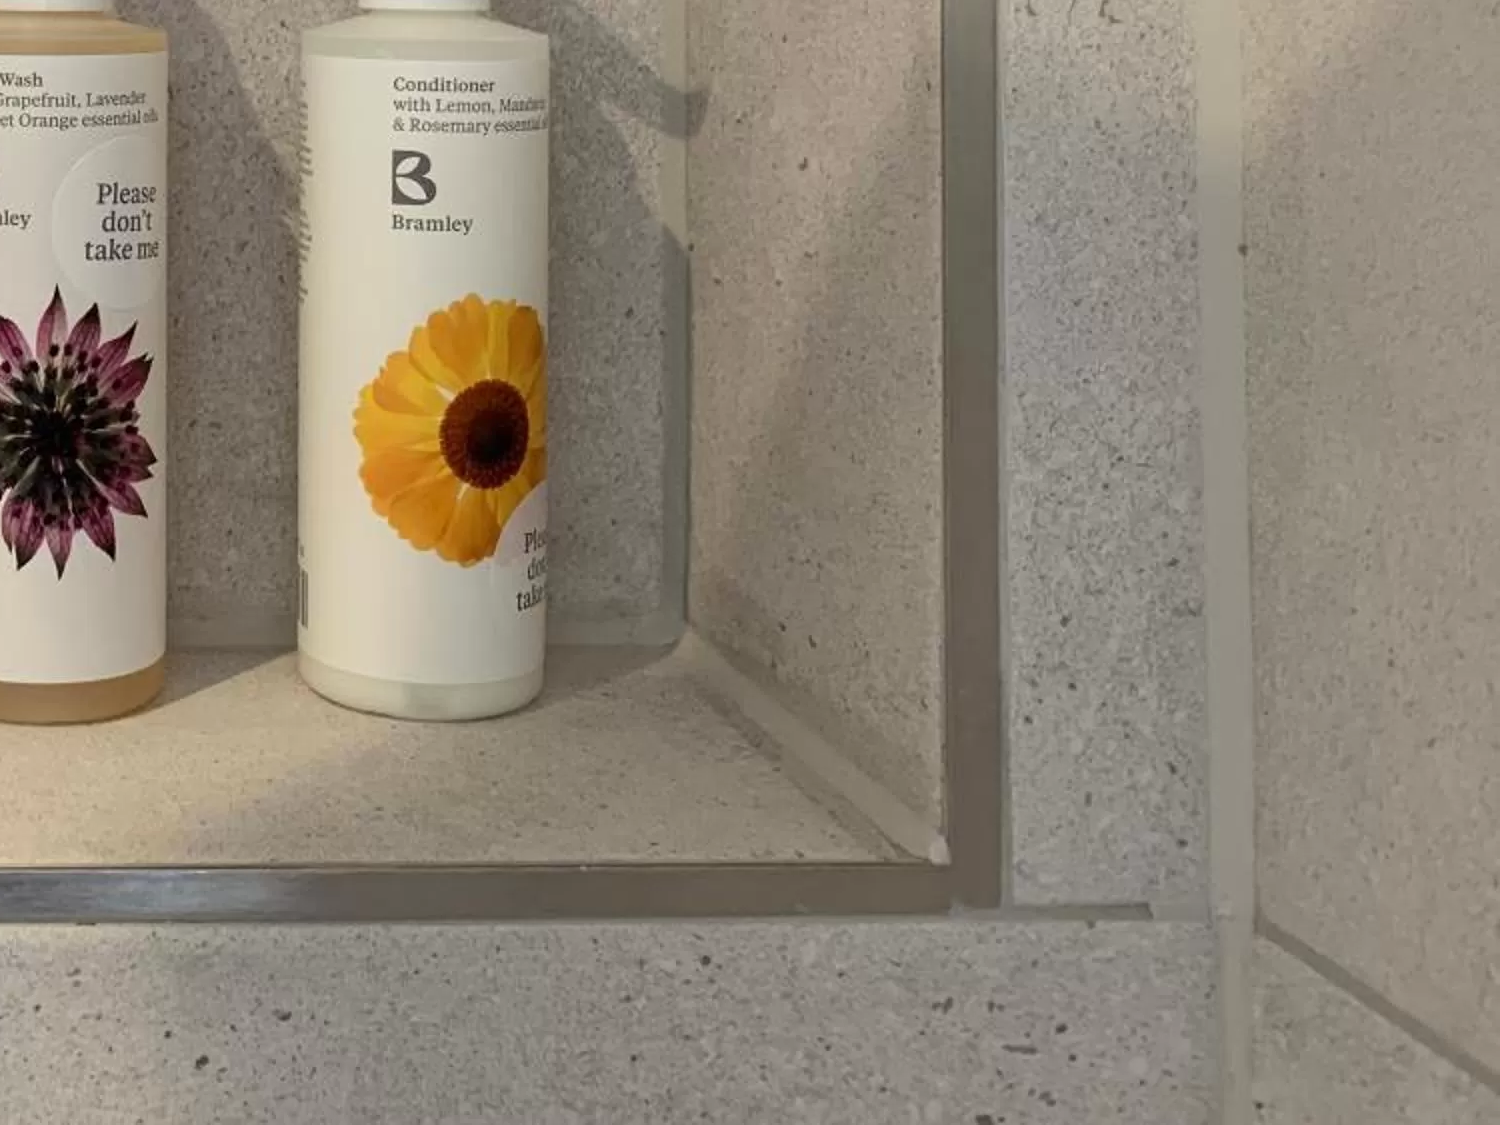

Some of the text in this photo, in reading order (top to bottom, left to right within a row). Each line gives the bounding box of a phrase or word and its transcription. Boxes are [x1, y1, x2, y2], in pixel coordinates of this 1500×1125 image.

[0, 72, 44, 88] Wash
[393, 76, 495, 93] Conditioner
[86, 91, 146, 107] Lavender
[393, 97, 431, 113] with
[435, 98, 495, 115] Lemon,
[18, 112, 79, 131] Orange
[81, 109, 141, 127] essential
[393, 117, 405, 132] &
[410, 118, 493, 136] Rosemary
[97, 182, 156, 206] Please
[102, 210, 152, 233] don't
[392, 214, 473, 236] Bramley
[85, 238, 159, 261] take me
